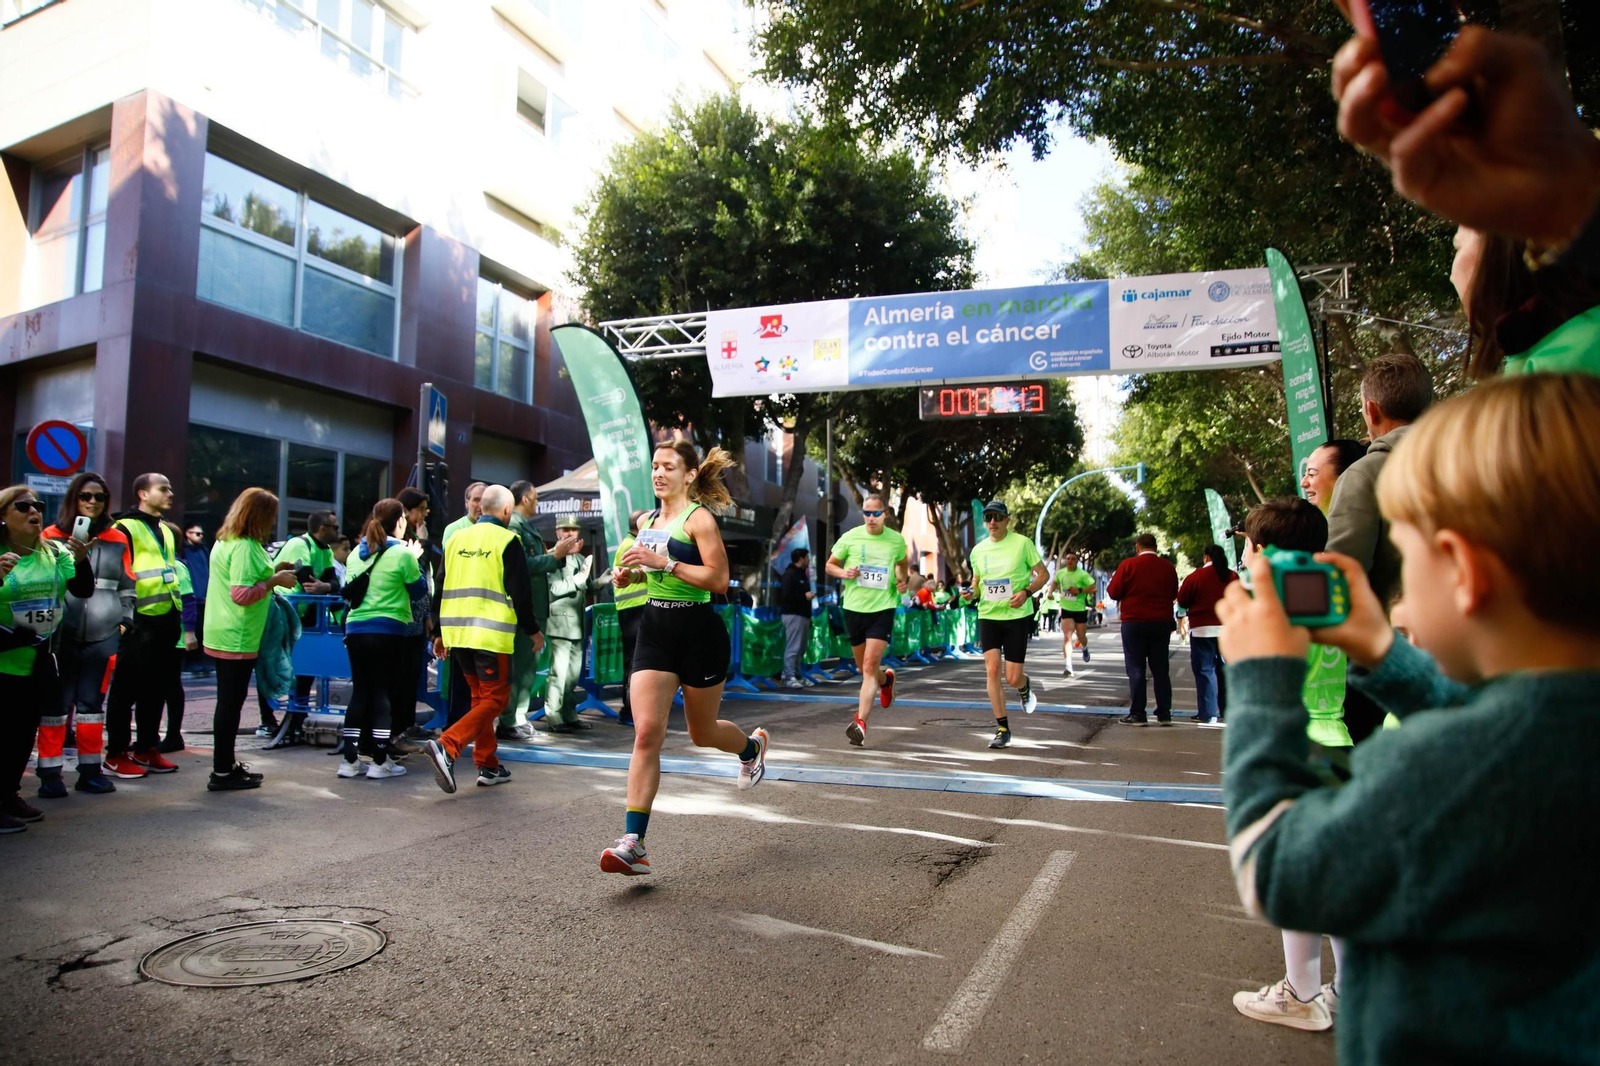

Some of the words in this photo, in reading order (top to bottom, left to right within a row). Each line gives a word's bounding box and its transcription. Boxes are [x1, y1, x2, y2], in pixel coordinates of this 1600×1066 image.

[1141, 288, 1192, 302] cajamar
[864, 301, 955, 325] Almería
[961, 301, 991, 318] en
[1000, 292, 1093, 316] marcha
[1143, 322, 1178, 330] MICHELIN
[1190, 315, 1251, 328] Fundación
[864, 332, 939, 351] contra
[946, 330, 969, 345] el
[975, 323, 1061, 343] cáncer
[1221, 333, 1242, 342] Ejido
[1244, 331, 1271, 339] Motor
[1079, 348, 1104, 356] española
[1146, 350, 1176, 358] Alborán
[1177, 349, 1199, 357] Motor
[858, 366, 934, 377] #TodosContraElCáncer
[863, 571, 883, 581] 315
[988, 585, 1006, 594] 573
[650, 600, 670, 609] NIKE
[671, 600, 694, 609] PRO
